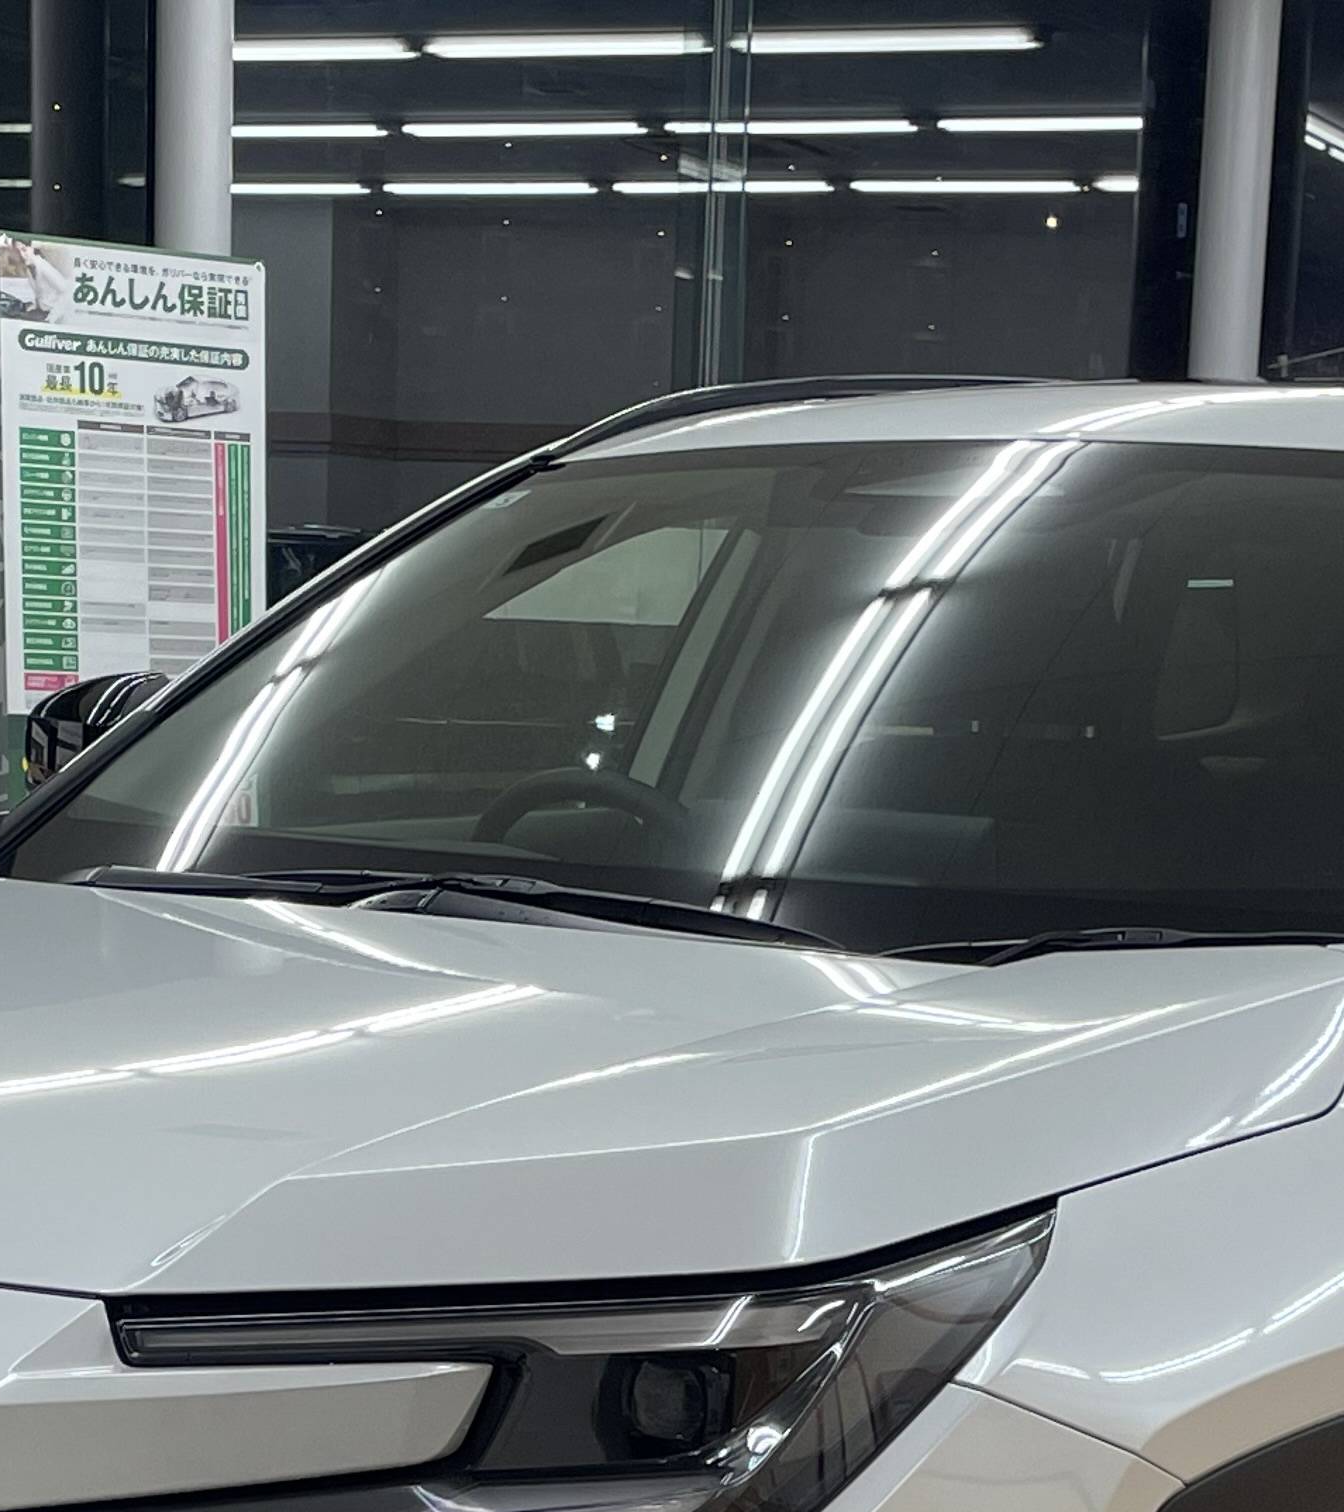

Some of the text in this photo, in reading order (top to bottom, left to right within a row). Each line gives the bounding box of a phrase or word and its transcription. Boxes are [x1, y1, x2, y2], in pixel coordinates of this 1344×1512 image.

[72, 271, 233, 321] あんしん保証
[23, 332, 82, 353] Gulliver
